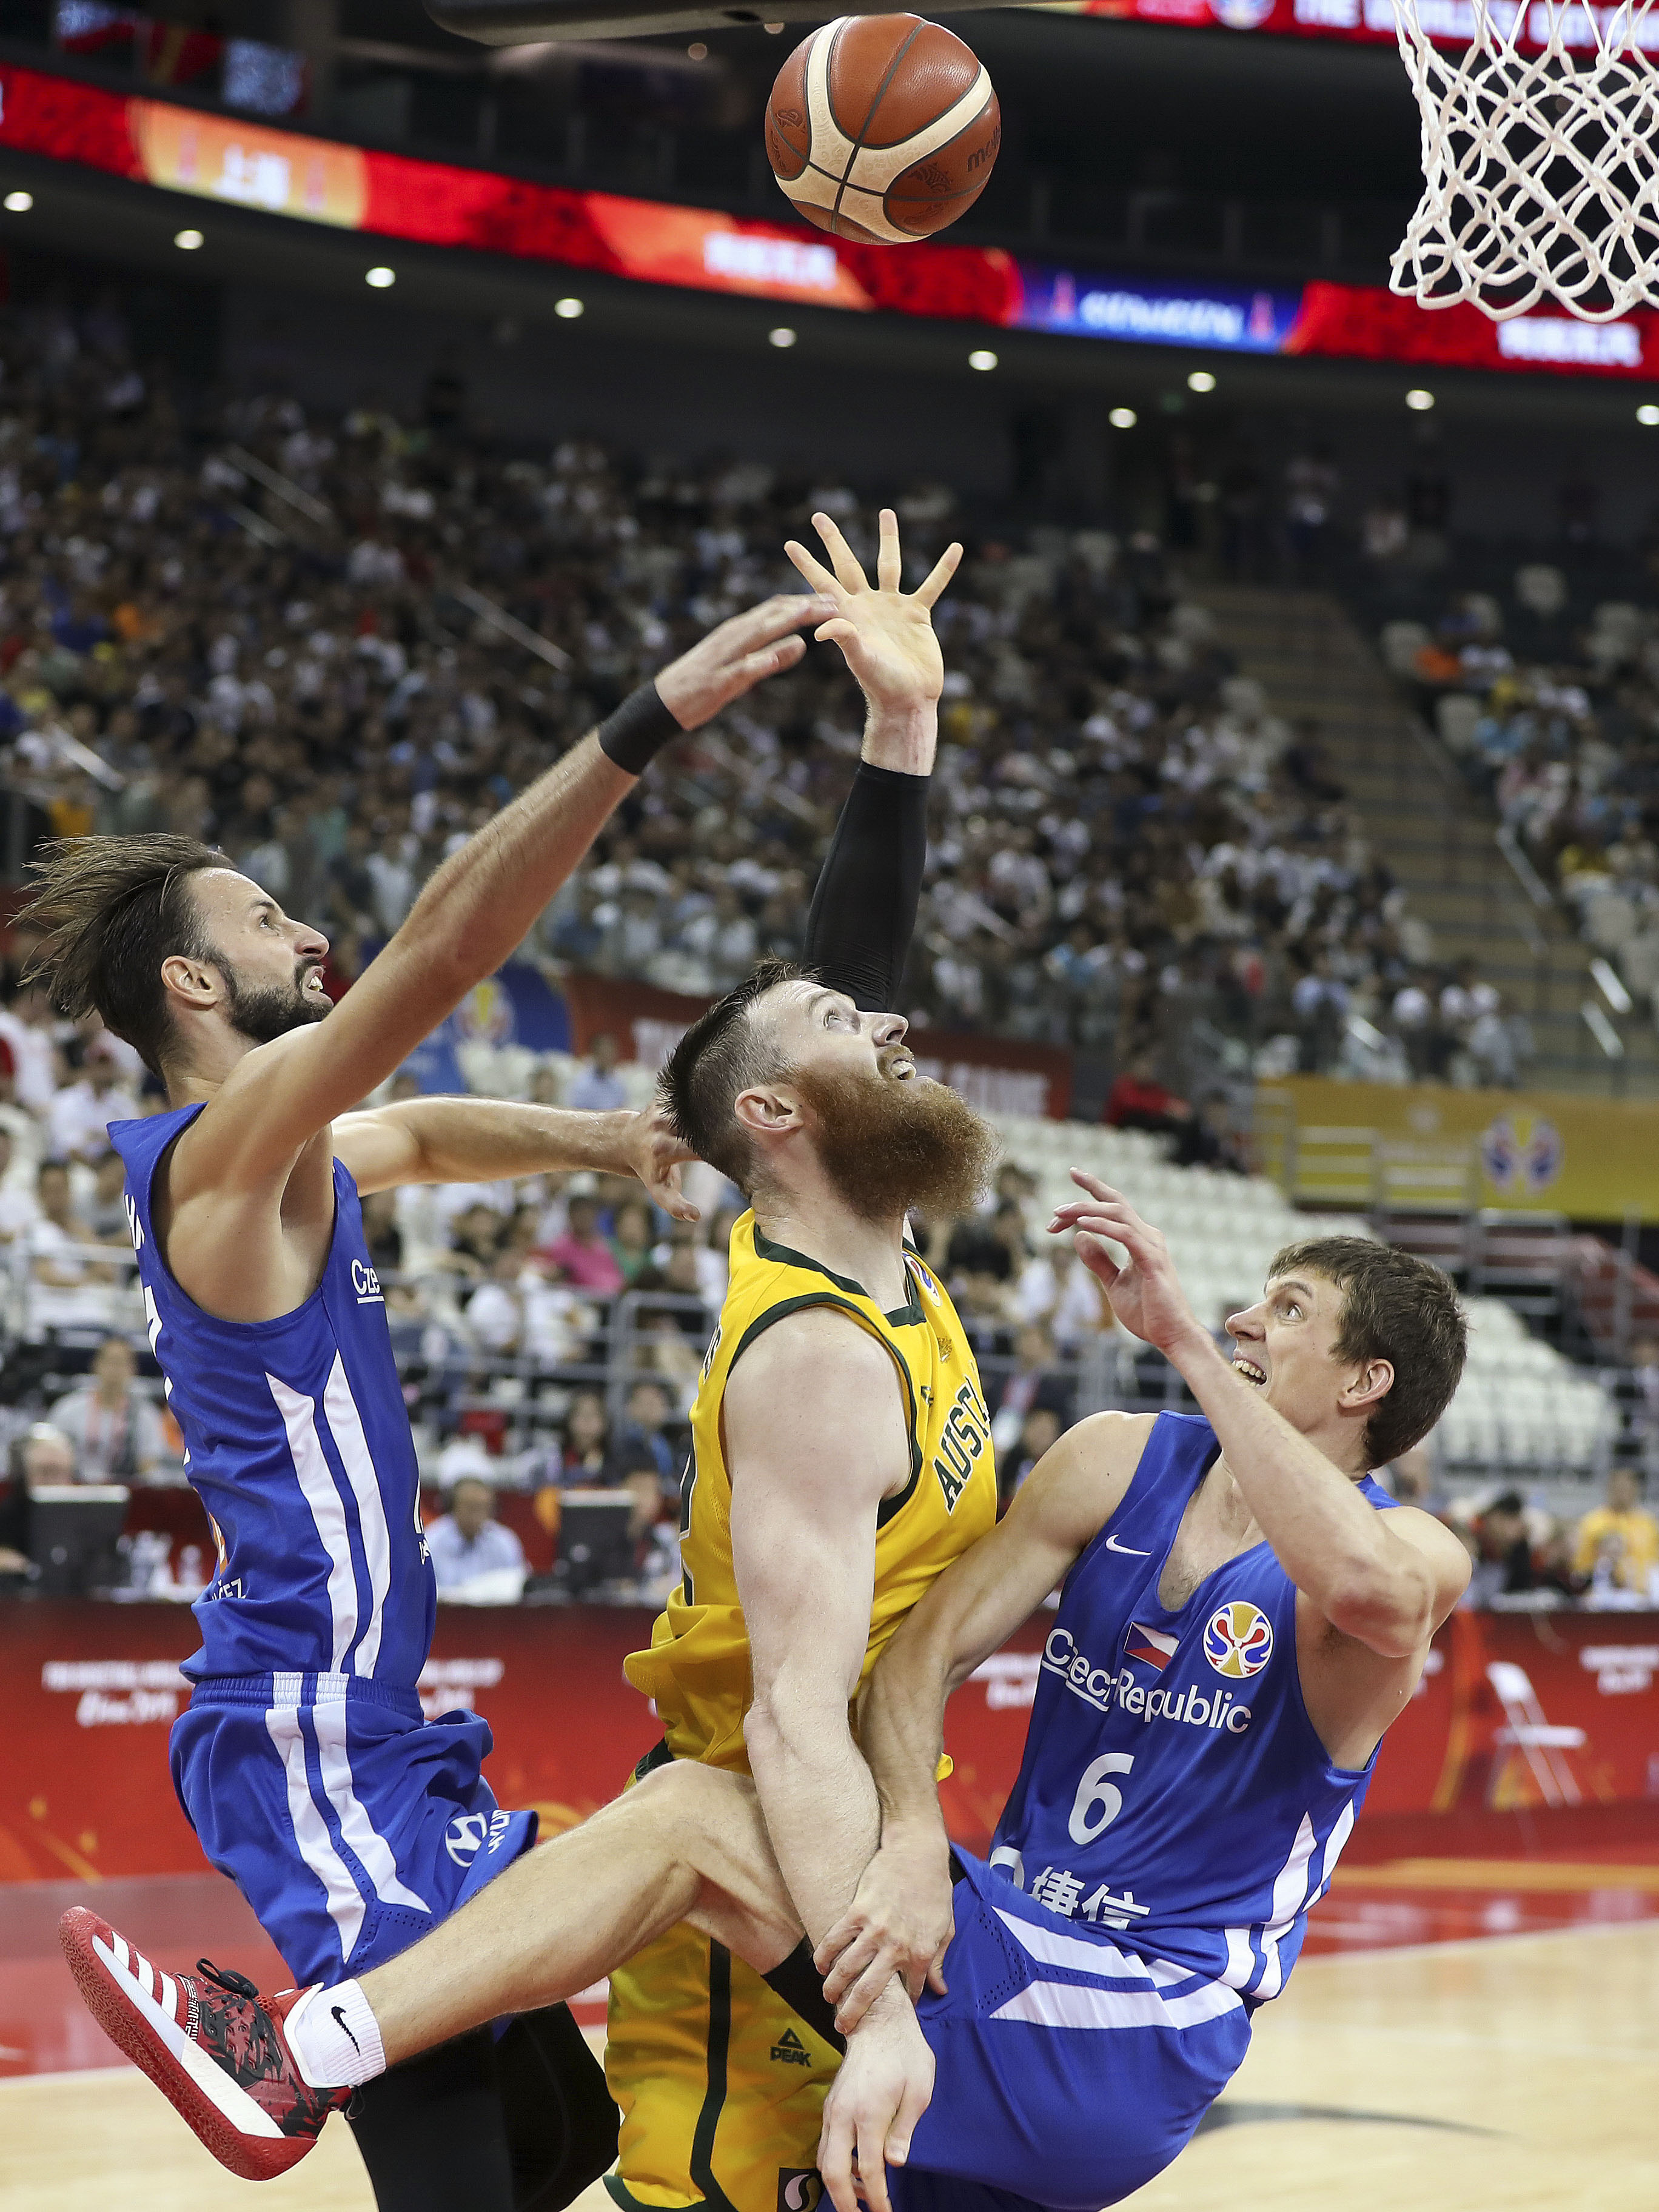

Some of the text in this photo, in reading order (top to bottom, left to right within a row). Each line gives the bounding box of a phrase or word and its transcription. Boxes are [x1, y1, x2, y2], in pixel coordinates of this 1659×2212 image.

[1113, 1667, 1252, 1734] Republic
[1067, 1752, 1136, 1846] 6
[1031, 1865, 1151, 1931] 捷信
[769, 2046, 813, 2068] PEAK
